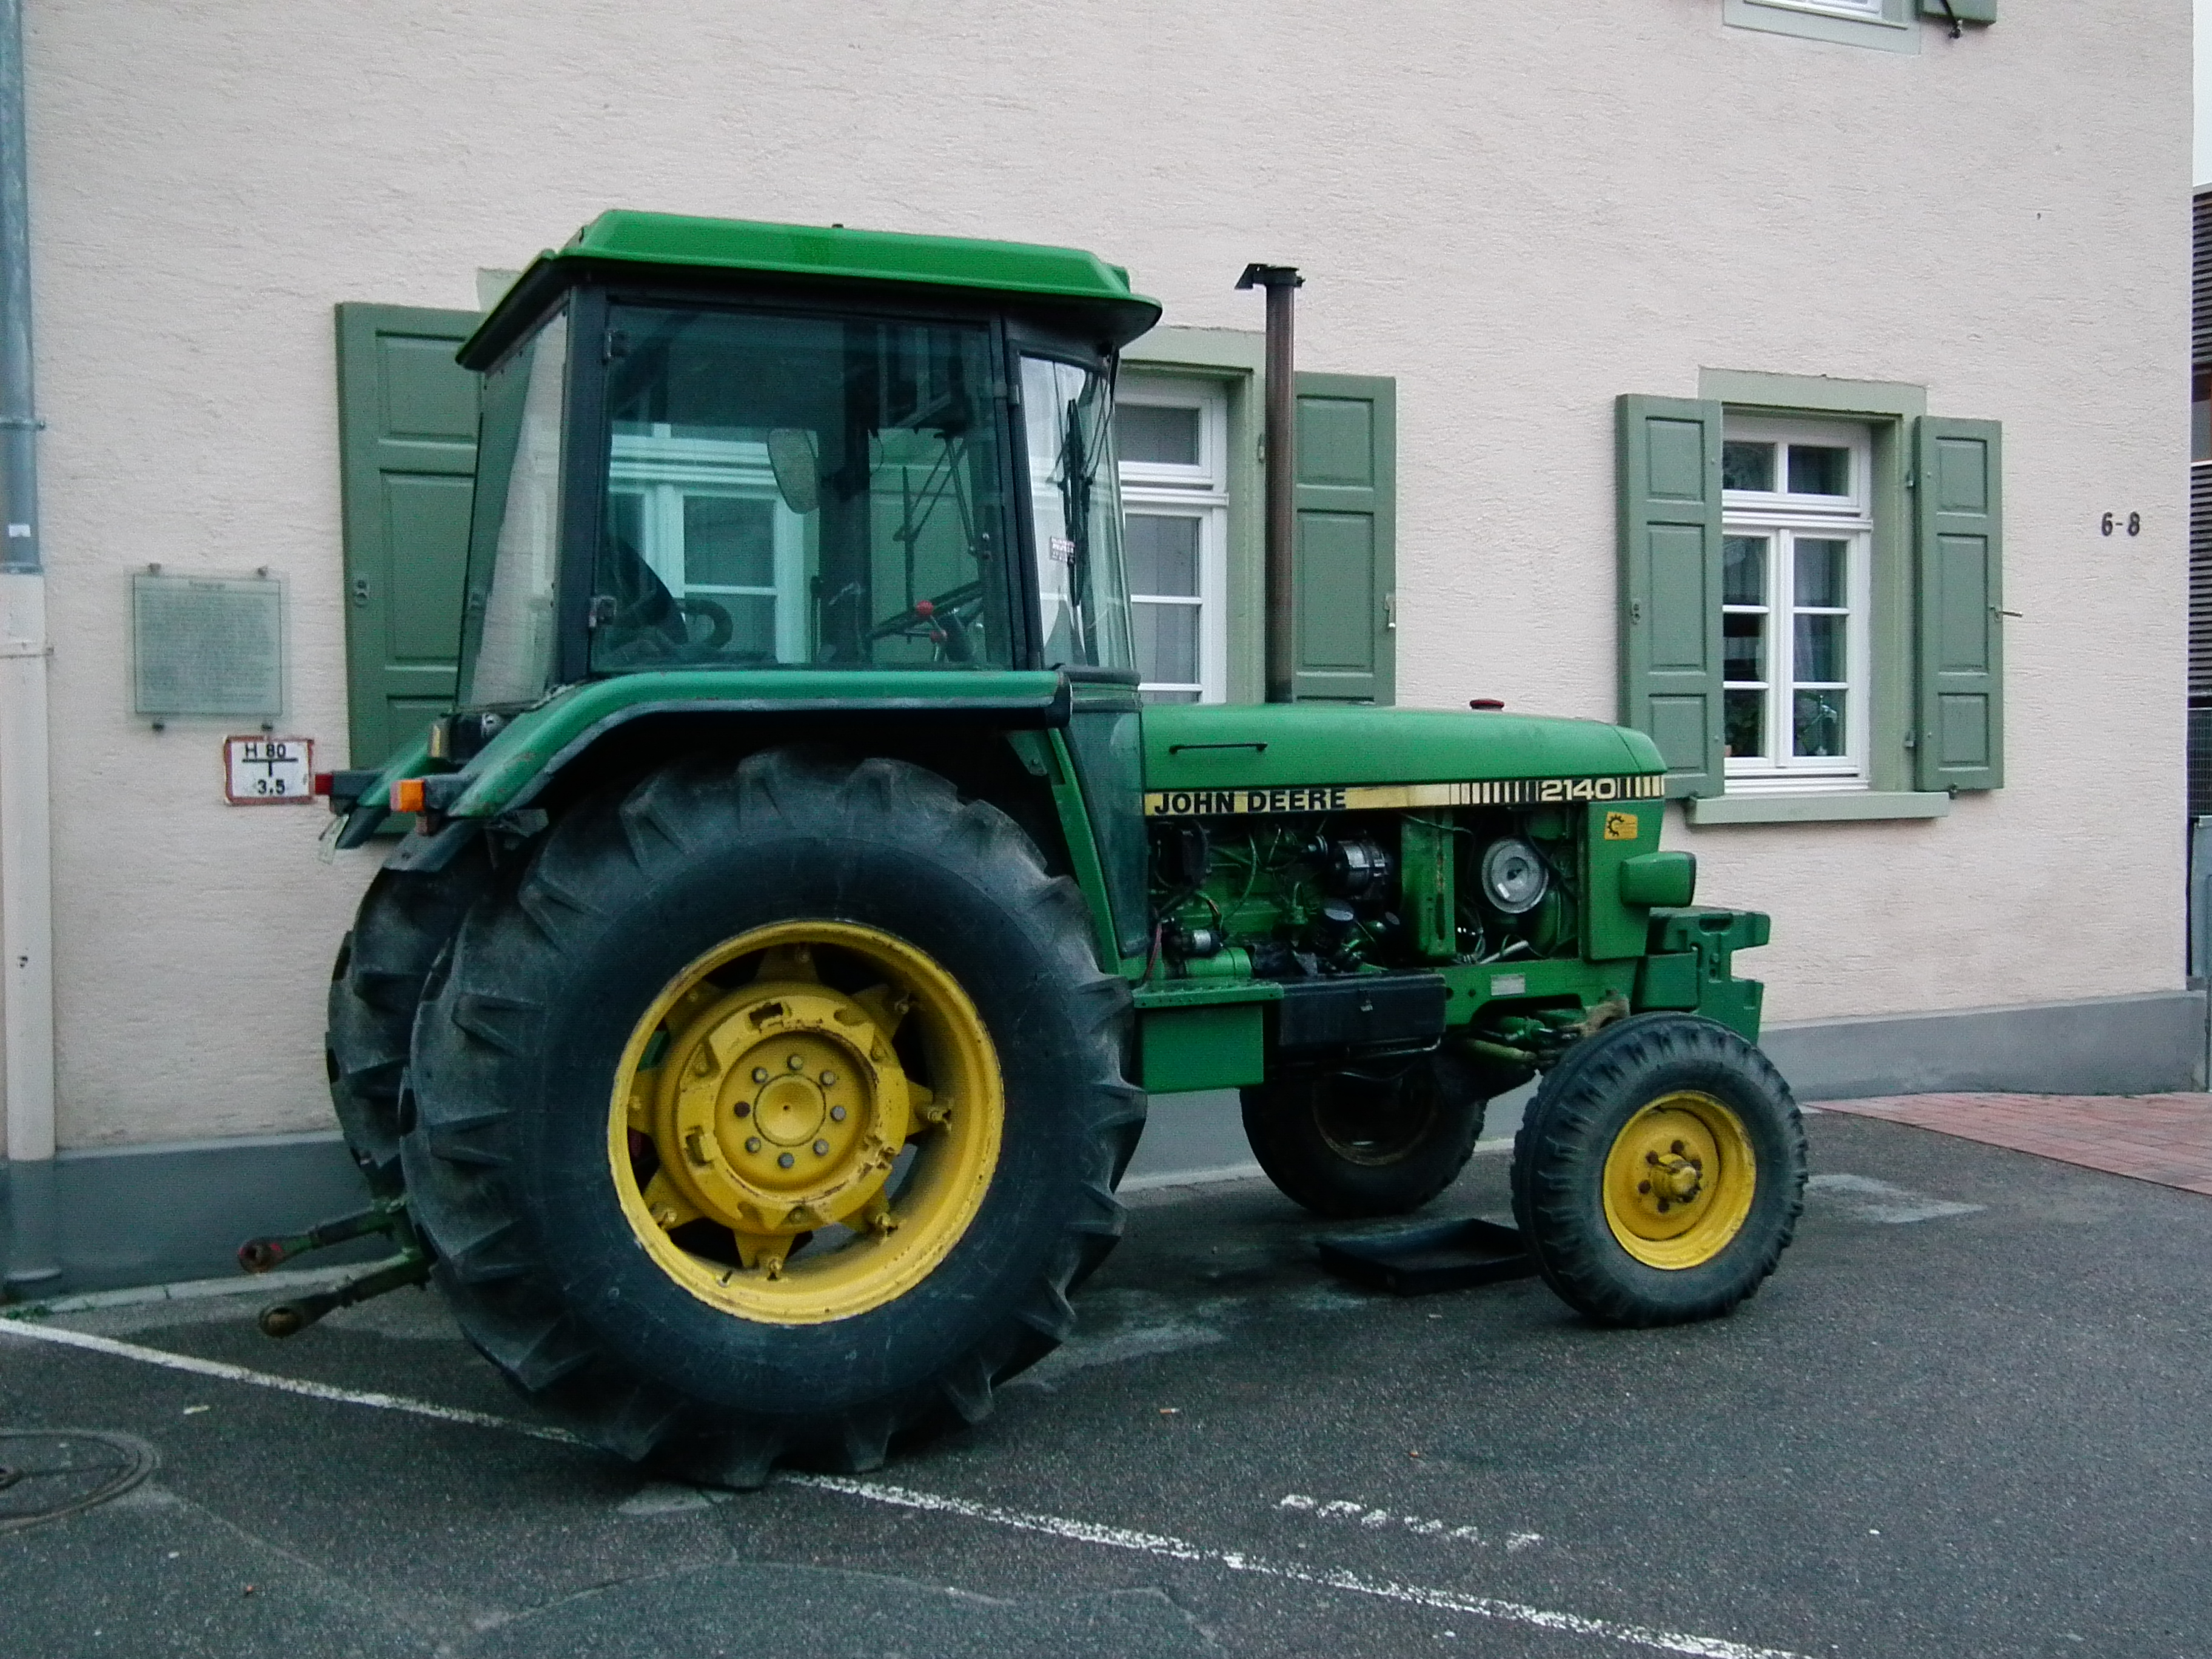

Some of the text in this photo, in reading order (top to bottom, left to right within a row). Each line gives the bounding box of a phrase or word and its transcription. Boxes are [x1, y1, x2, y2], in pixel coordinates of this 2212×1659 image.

[2101, 511, 2140, 537] 6-8
[245, 742, 286, 758] H 80
[257, 779, 286, 795] 3.5
[1541, 777, 1617, 802] 2140
[1155, 789, 1347, 814] JOHN DEERE
